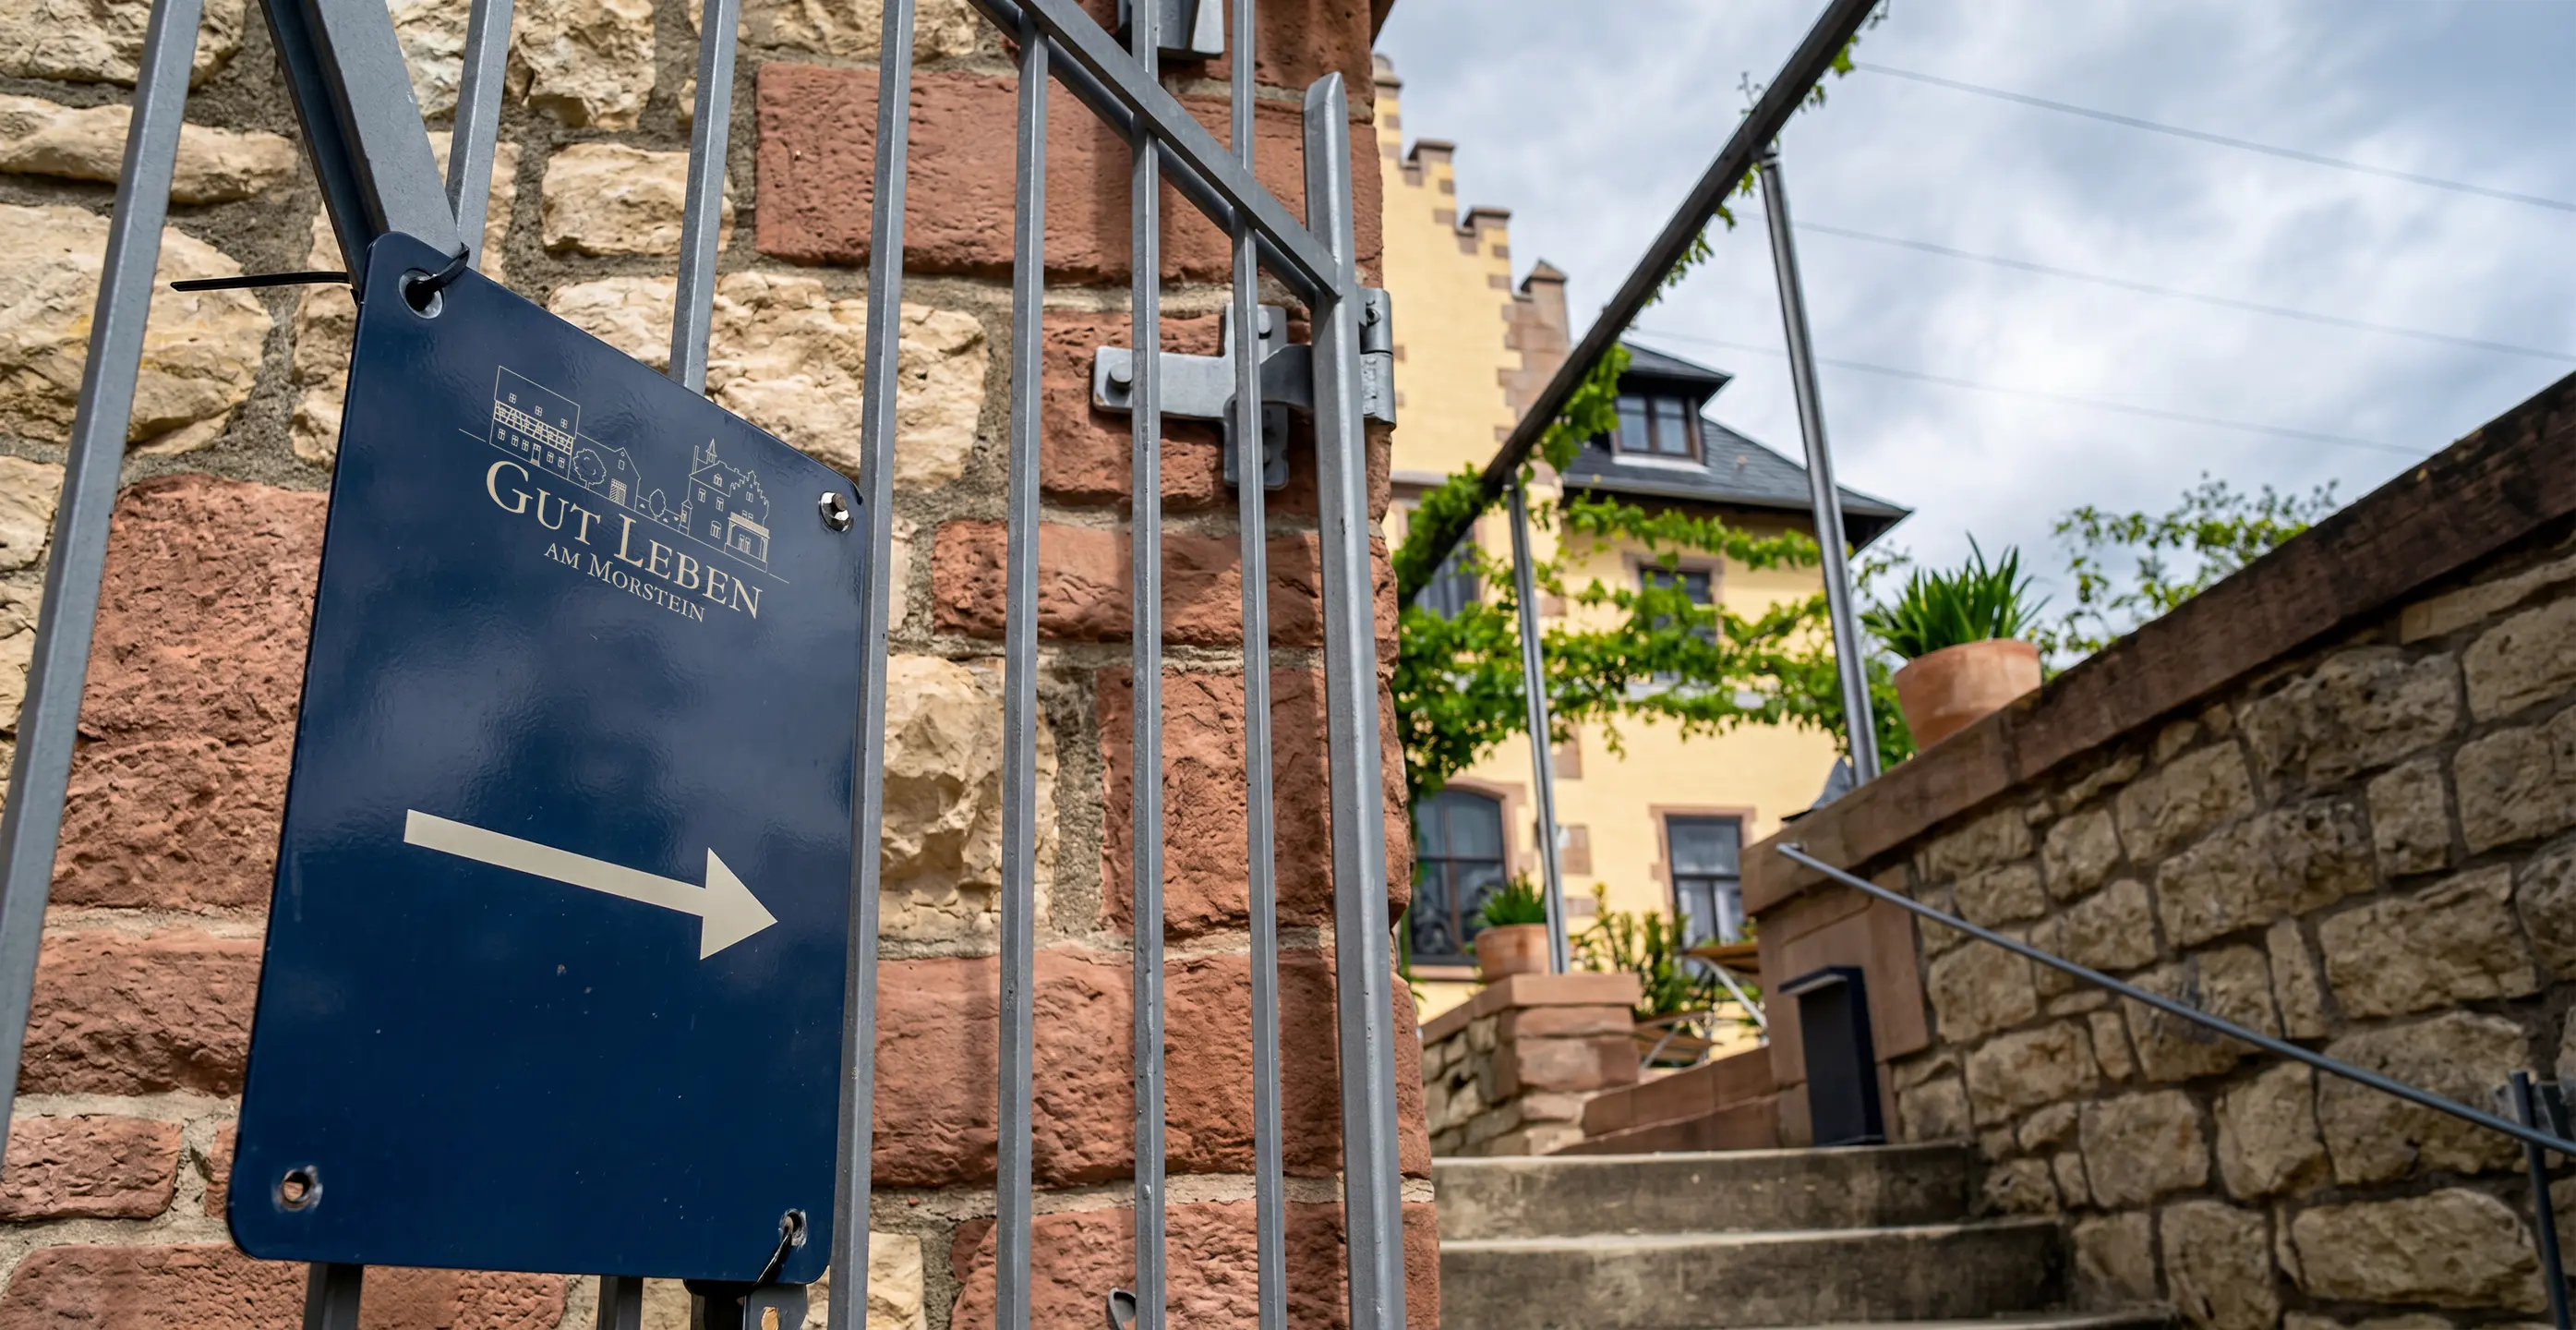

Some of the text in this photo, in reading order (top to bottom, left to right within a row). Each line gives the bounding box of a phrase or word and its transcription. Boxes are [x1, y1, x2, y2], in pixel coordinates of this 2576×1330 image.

[486, 460, 764, 620] GUT LEBEN
[544, 542, 705, 623] AM MORSTEIN
